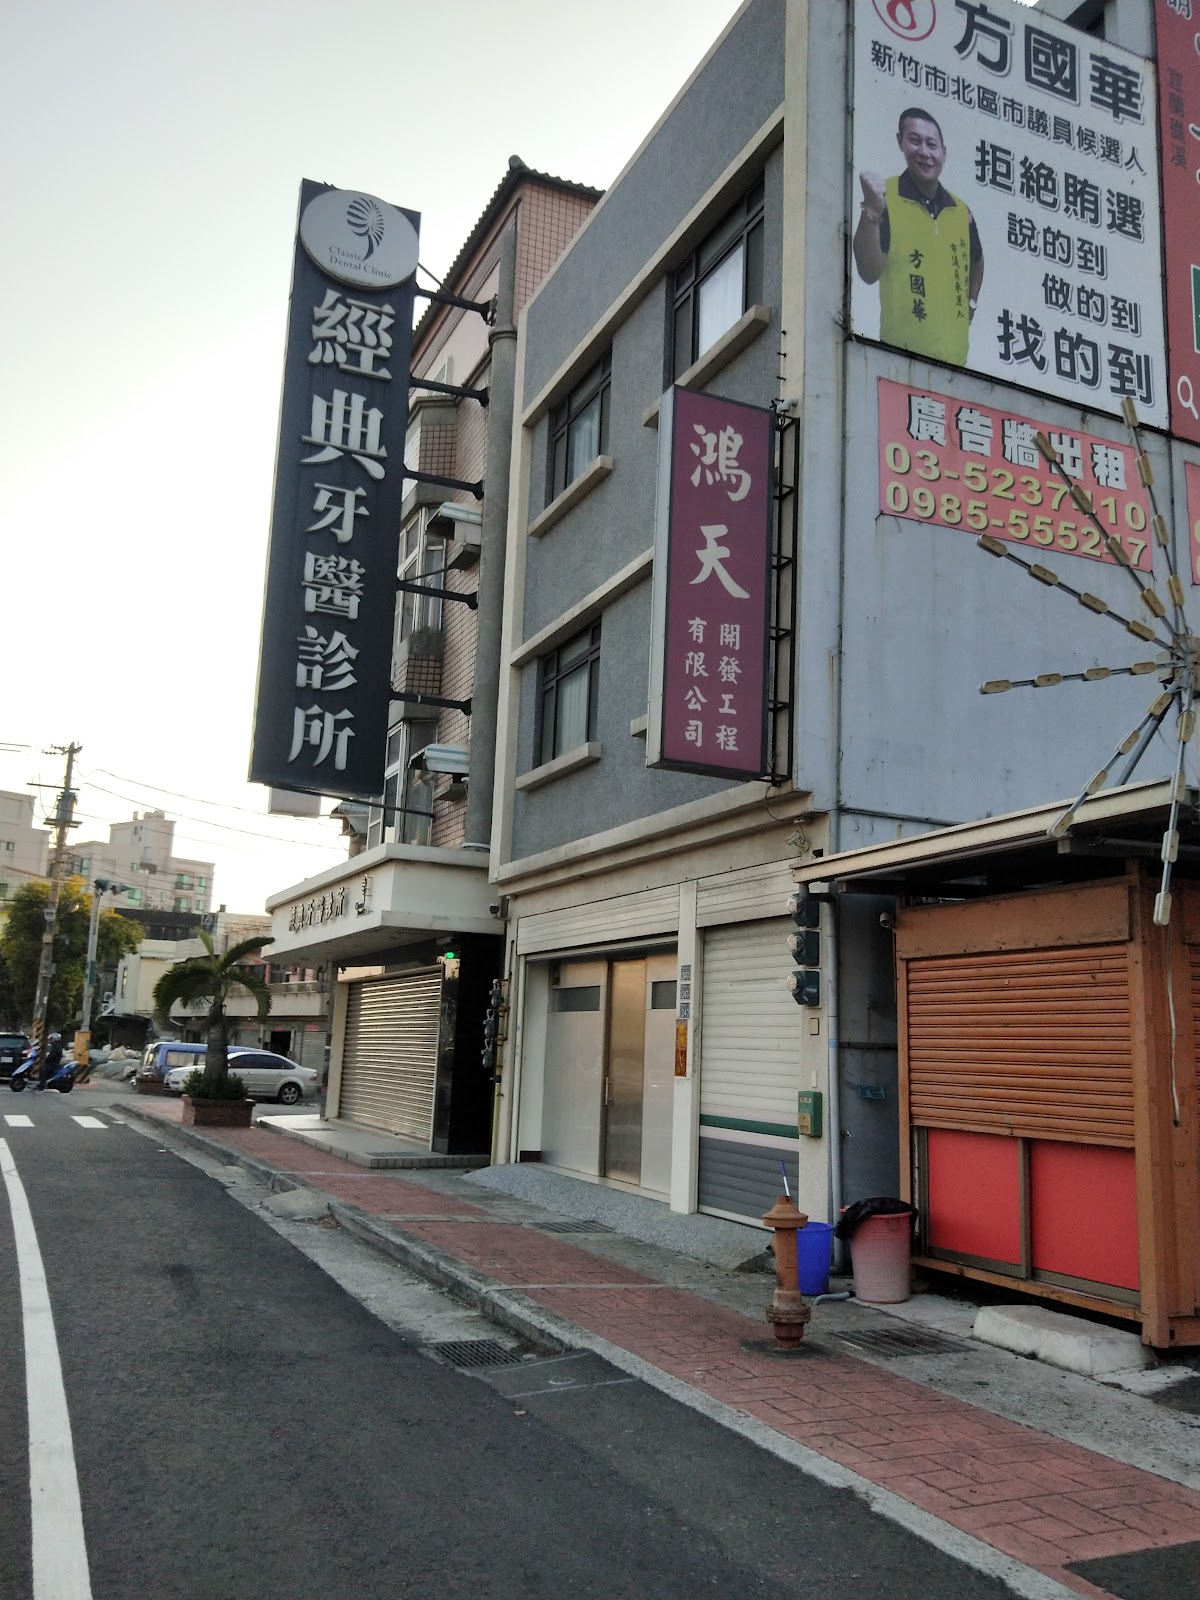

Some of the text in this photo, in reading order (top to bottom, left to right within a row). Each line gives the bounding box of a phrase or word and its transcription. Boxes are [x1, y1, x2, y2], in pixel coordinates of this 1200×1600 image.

[871, 40, 1145, 174] 新竹市北區市議員候選人
[953, 0, 1142, 122] 方國華
[329, 245, 362, 261] Classic
[330, 256, 392, 279] Dental Clinic
[909, 248, 928, 323] 方國華
[1007, 212, 1106, 277] 說的到
[1041, 272, 1139, 335] 做的到
[996, 308, 1153, 405] 找的到
[907, 393, 1127, 491] 廣告牆出租
[287, 288, 396, 771] 經典牙醫診所
[689, 424, 752, 600] 鴻天
[684, 616, 709, 748] 有限公司
[715, 622, 742, 752] 開發工程
